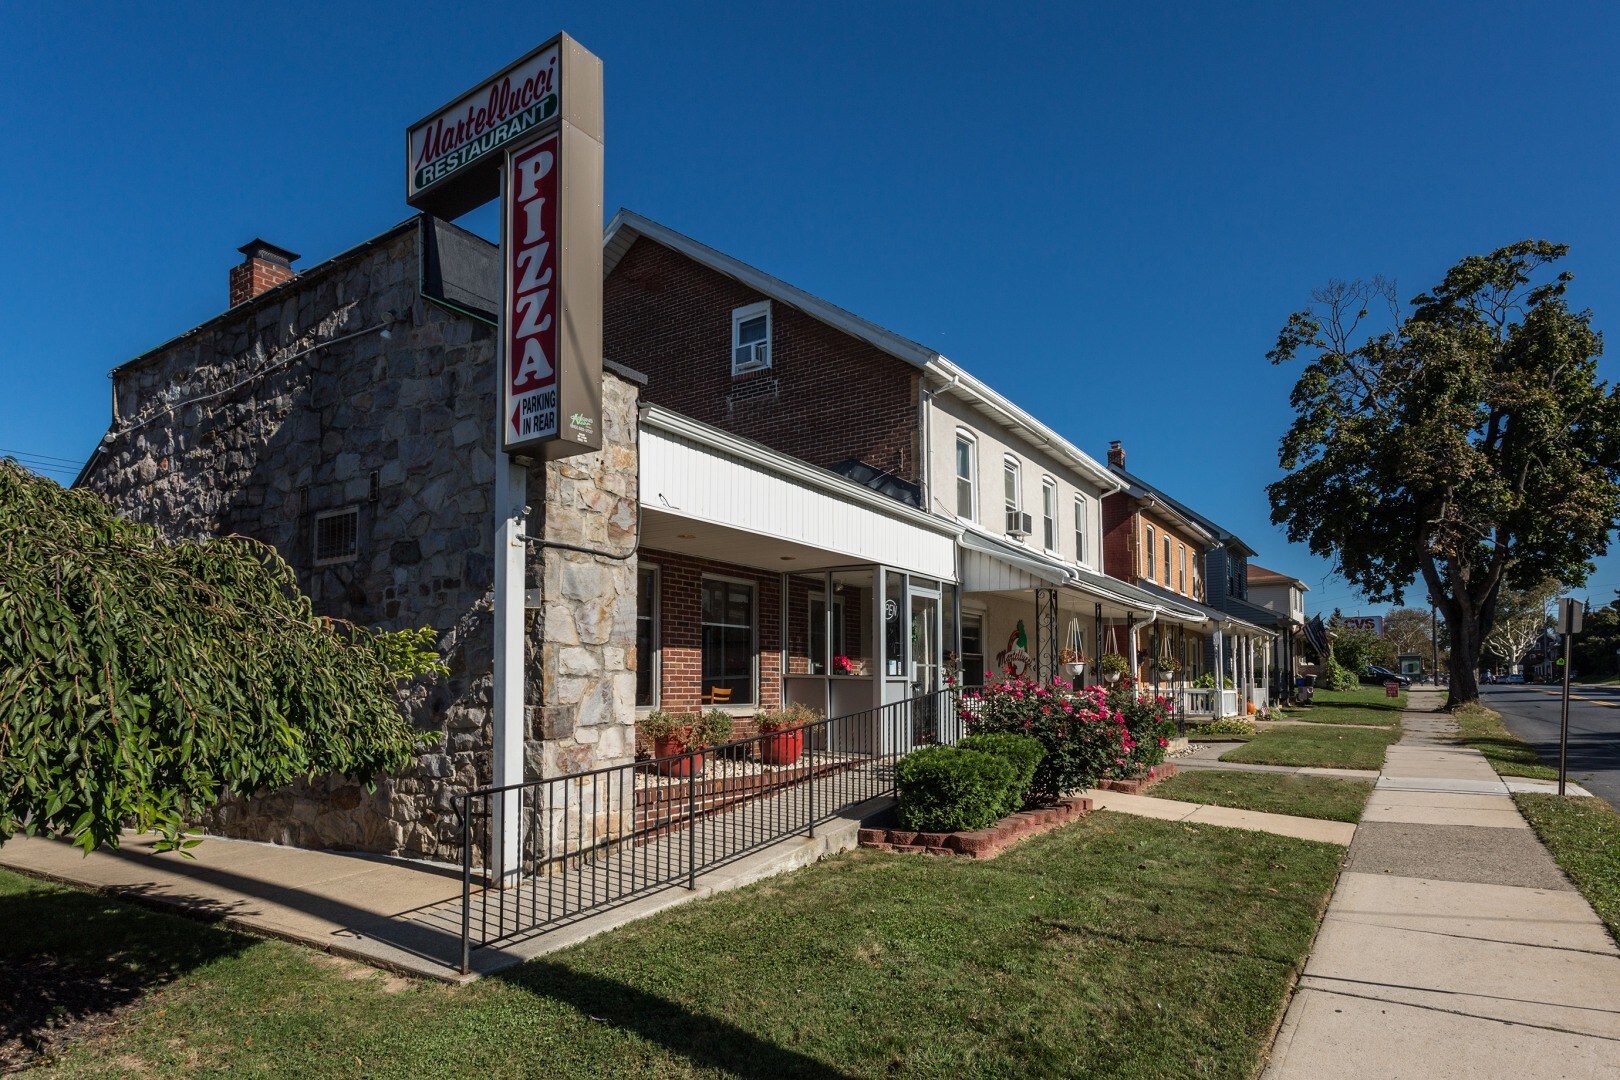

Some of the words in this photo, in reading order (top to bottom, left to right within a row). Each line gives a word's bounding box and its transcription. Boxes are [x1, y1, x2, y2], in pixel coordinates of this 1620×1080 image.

[422, 98, 549, 185] RESTAURANT
[516, 151, 553, 386] PIZZA
[523, 391, 556, 415] PARKING
[523, 418, 531, 435] IN
[533, 412, 555, 432] REAR
[1343, 618, 1375, 629] CVS
